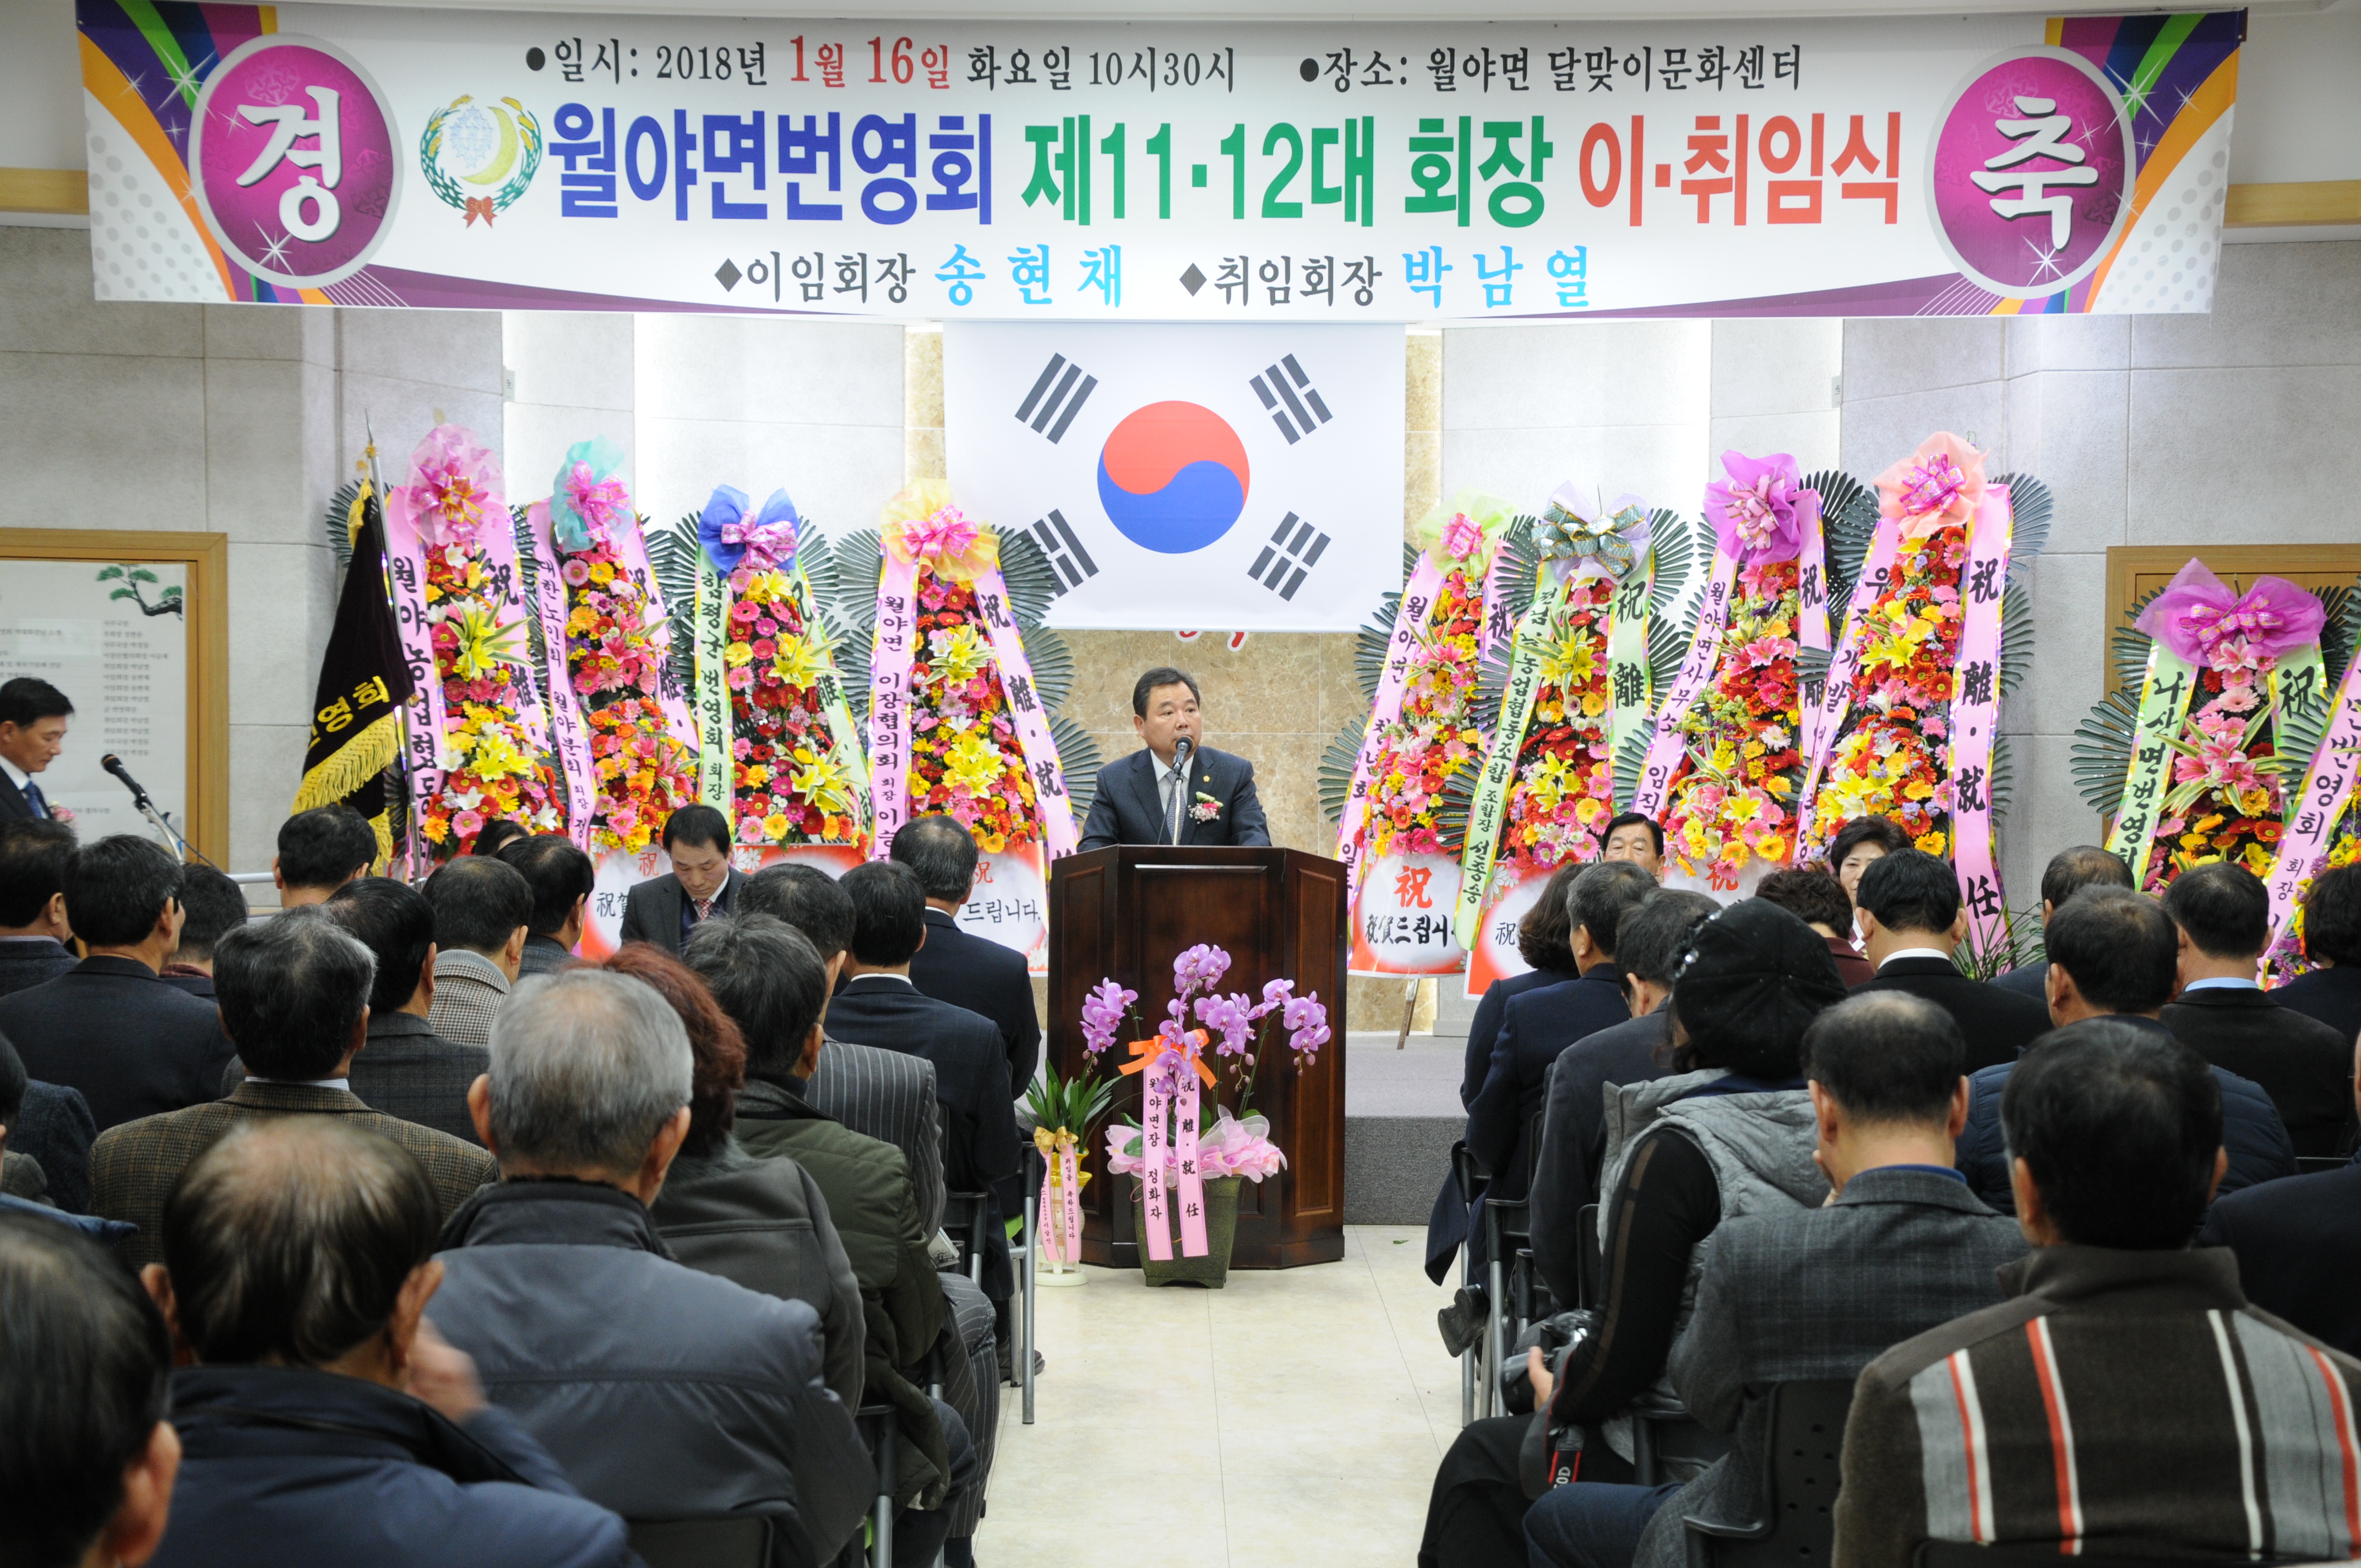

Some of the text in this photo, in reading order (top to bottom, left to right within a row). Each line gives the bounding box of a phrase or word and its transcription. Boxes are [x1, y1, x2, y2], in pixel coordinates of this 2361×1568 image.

[554, 35, 1234, 93] 일시: 2018년 1월 16일 화요일 10시30시
[1324, 44, 1802, 93] 장소: 월야면 달맞이문화센터
[235, 84, 341, 242] 경
[548, 102, 992, 225] 월야면번영회
[1404, 115, 1554, 228] 회장
[1579, 111, 1902, 227] 이·취임식
[1969, 95, 2099, 252] 축
[747, 251, 917, 304] 이임회장
[1214, 254, 1383, 307] 취임회장
[881, 596, 909, 652] 월야면
[700, 571, 727, 801] 함평군 번영회 회장
[875, 672, 902, 771] 이장협의회
[574, 784, 589, 809] 회장
[881, 777, 897, 802] 회장
[1477, 789, 1498, 832] 조합장
[638, 852, 660, 876] 祝
[1393, 864, 1433, 908] 祝
[2276, 858, 2304, 900] 회장
[1495, 922, 1517, 946] 祝
[1553, 1466, 1571, 1489] 0D
